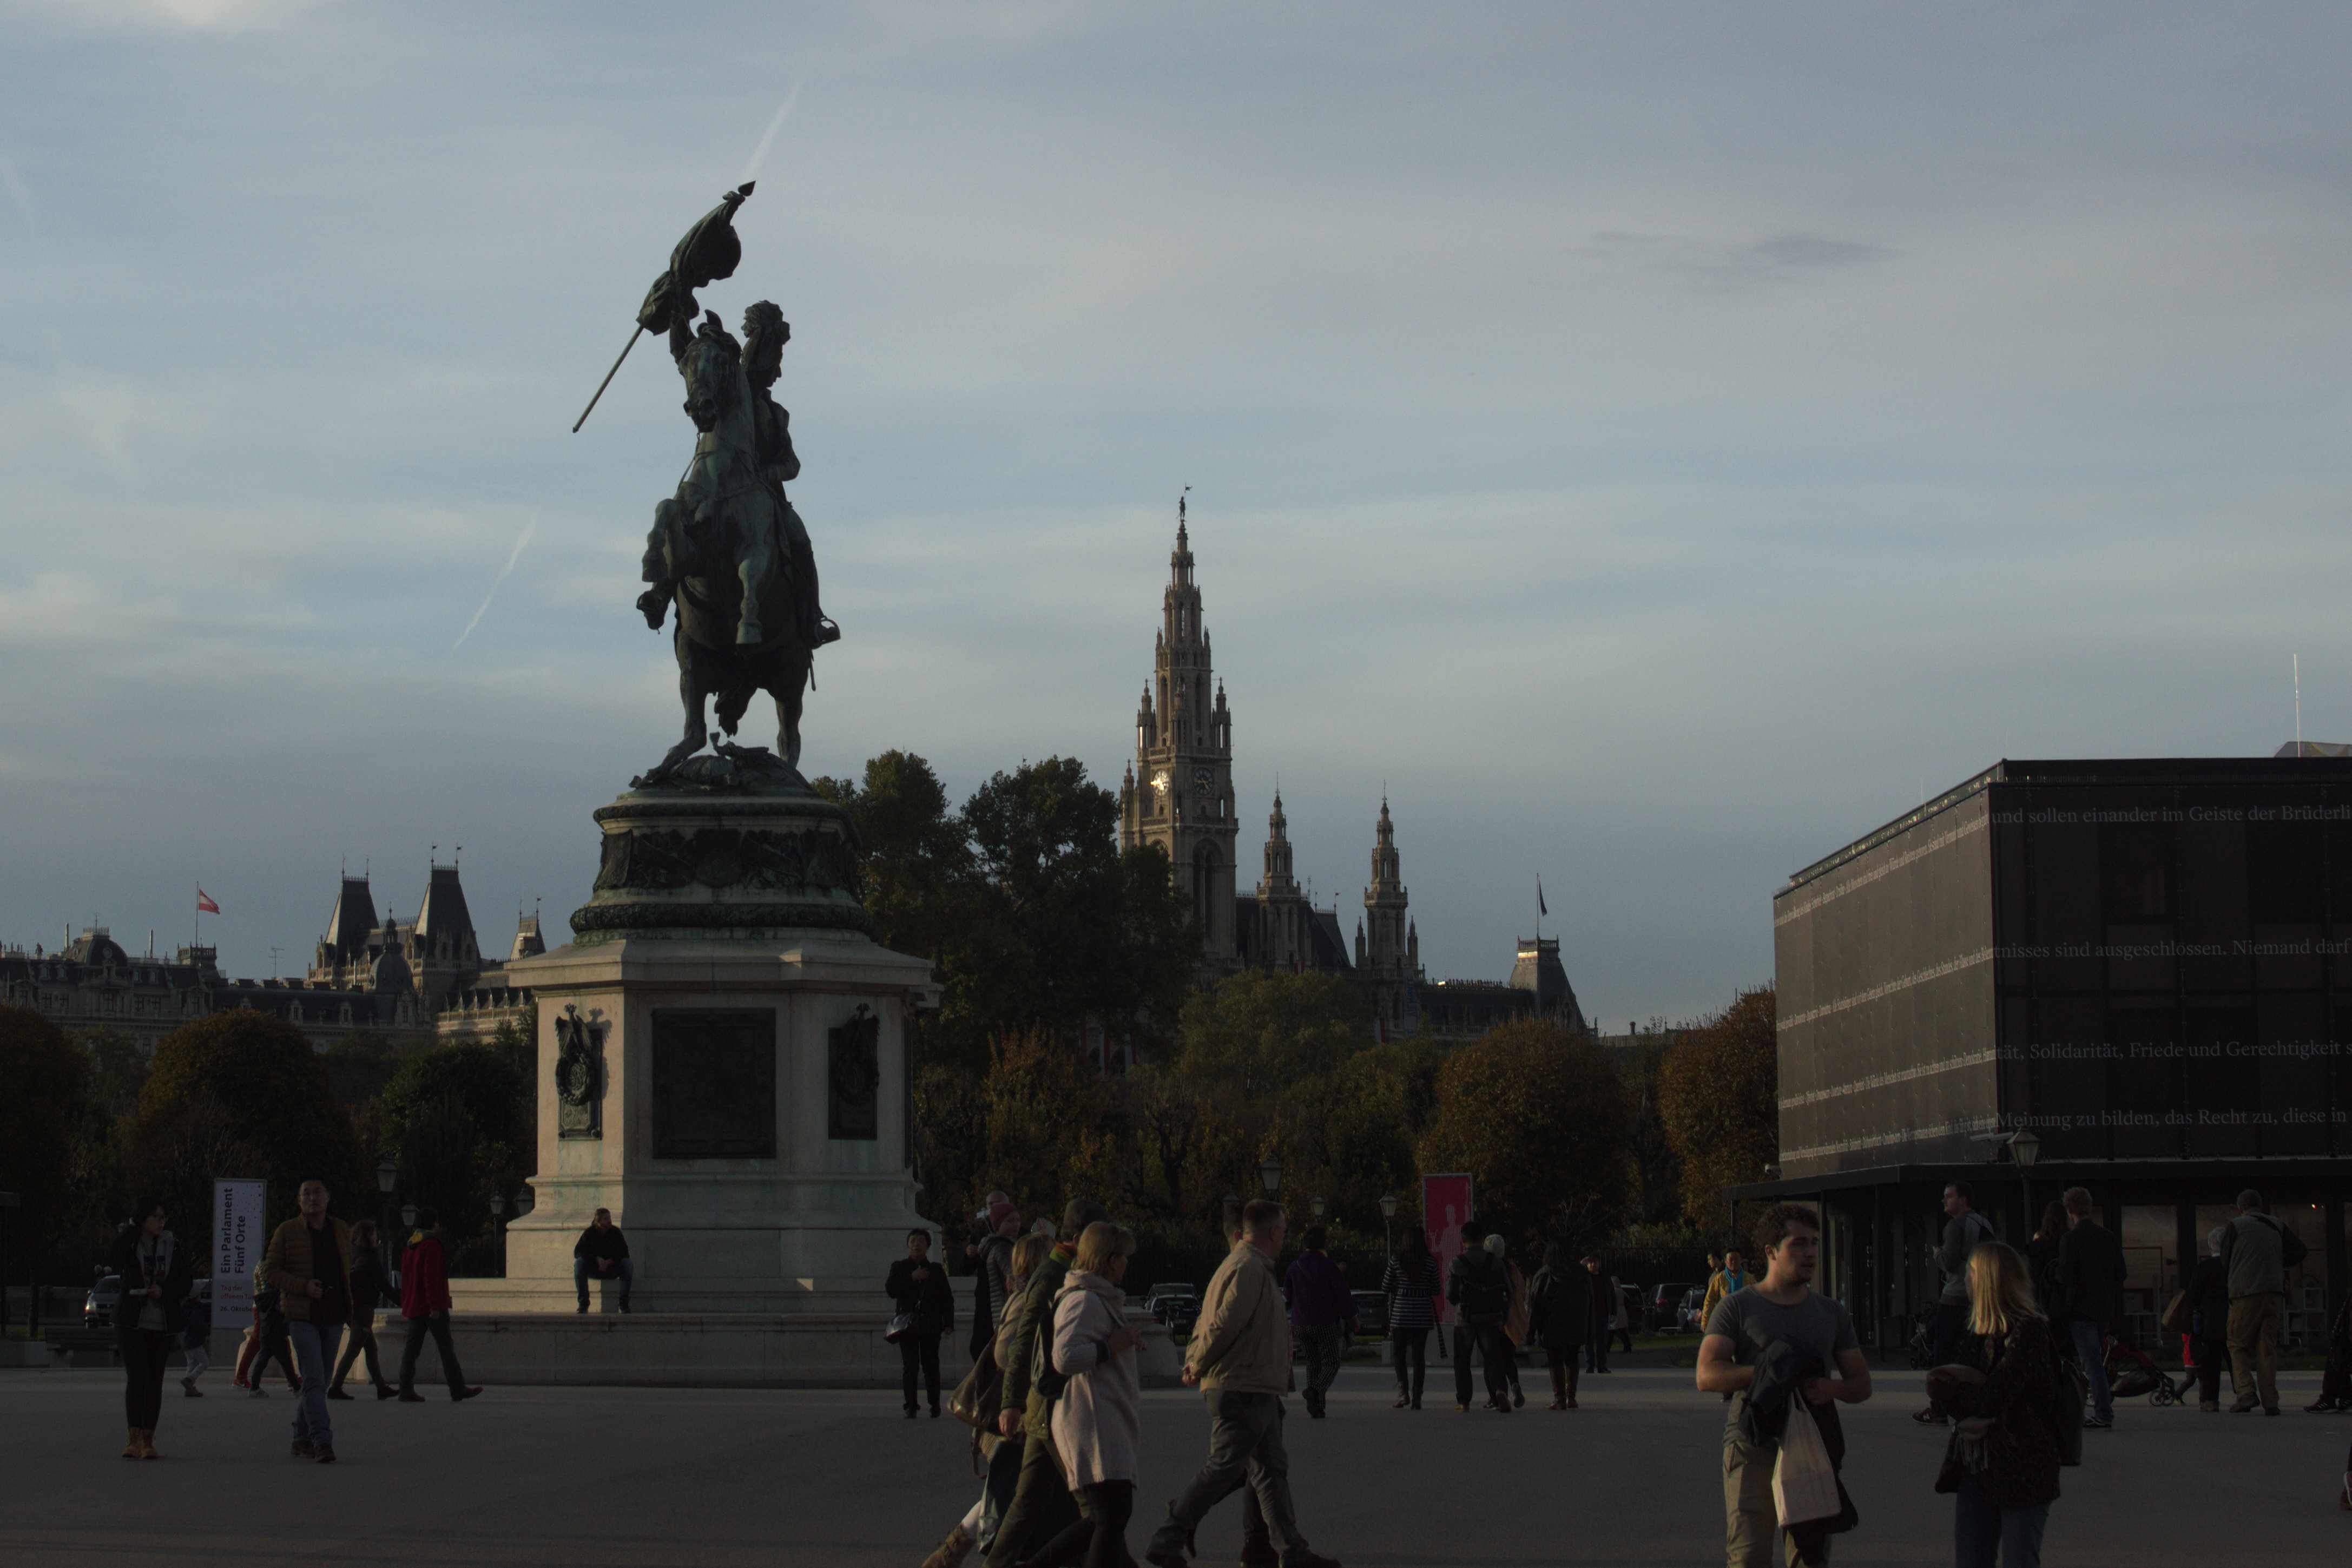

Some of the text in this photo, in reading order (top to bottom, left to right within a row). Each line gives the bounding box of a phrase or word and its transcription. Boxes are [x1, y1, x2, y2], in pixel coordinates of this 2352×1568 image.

[1991, 808, 2024, 823] und
[2029, 807, 2078, 823] sollen
[2083, 807, 2157, 822] einander
[2162, 806, 2184, 821] im
[2189, 806, 2243, 821] Geiste
[2248, 805, 2276, 821] der
[2055, 942, 2090, 957] sind
[2096, 940, 2227, 960] ausgeschlossen.
[2232, 938, 2311, 956] Niemand
[2316, 938, 2352, 954] darf
[2030, 1043, 2124, 1060] Solidarität,
[2129, 1041, 2184, 1058] Friede
[2189, 1041, 2221, 1057] und
[2226, 1039, 2341, 1060] Gerechtigkeit
[1996, 1106, 2347, 1130] Meinung zu bilden, das Recht zu, diese in
[221, 1188, 233, 1273] Ein Parlament
[234, 1215, 246, 1273] Fünf Orte
